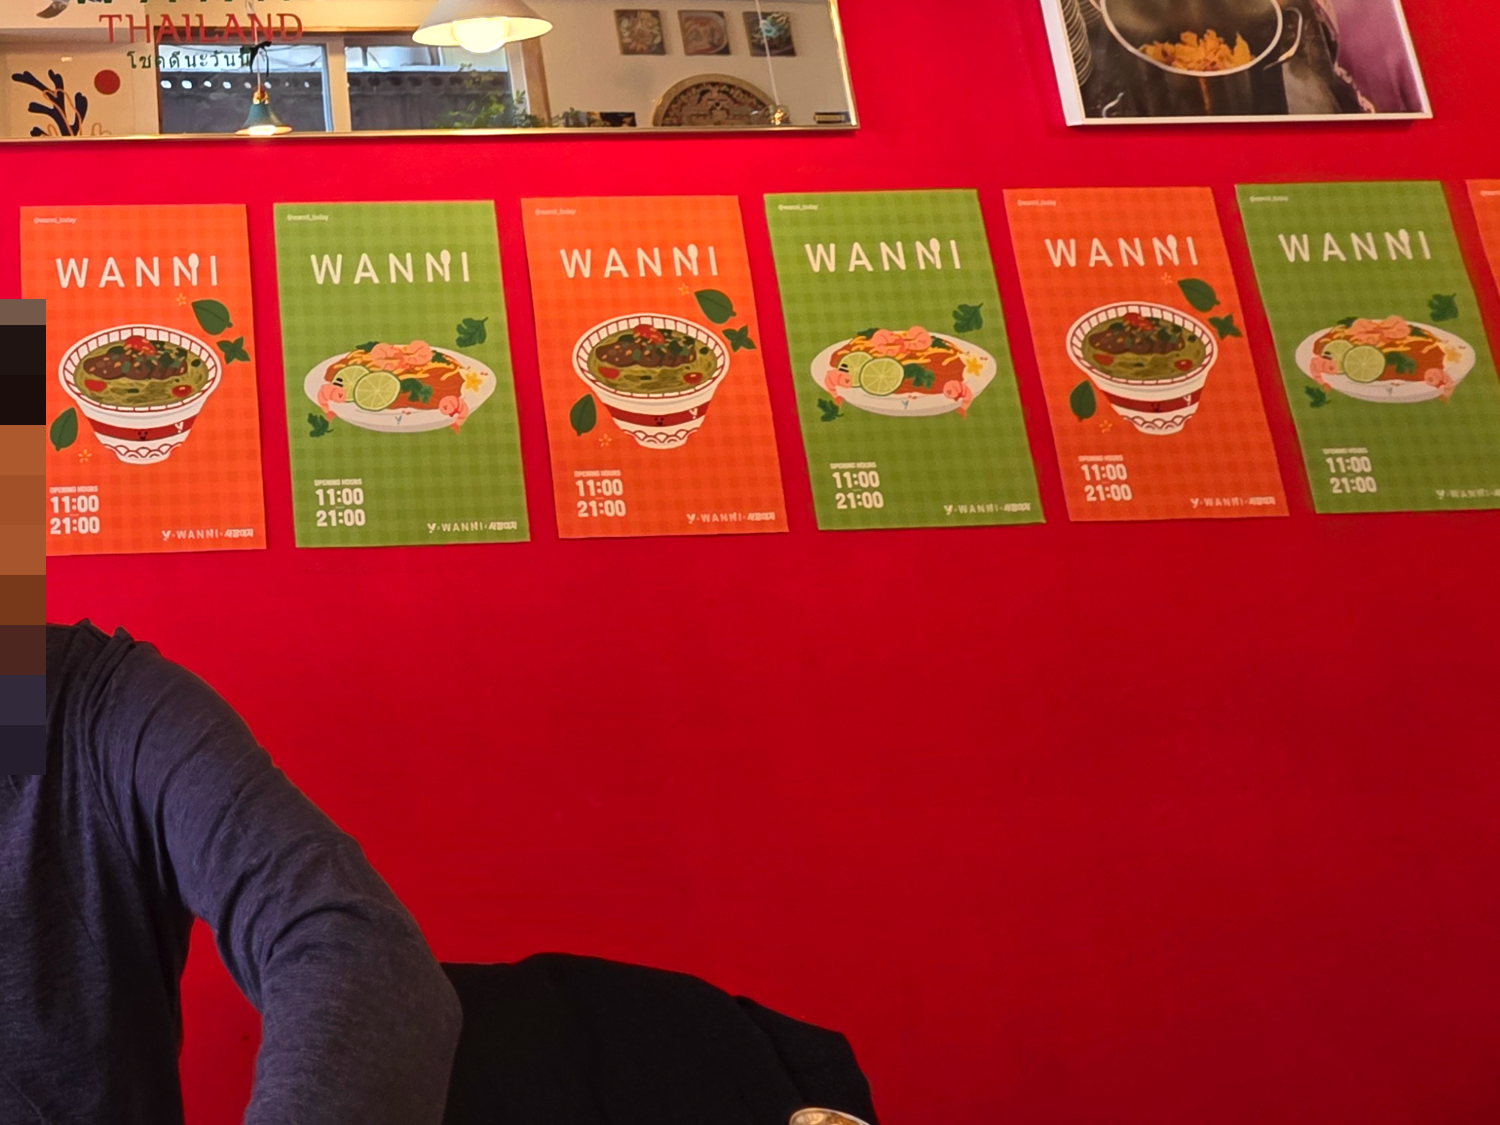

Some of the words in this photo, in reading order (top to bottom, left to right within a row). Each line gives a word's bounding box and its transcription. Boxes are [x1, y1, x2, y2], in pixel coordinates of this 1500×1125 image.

[99, 12, 304, 44] THAILAND
[804, 237, 961, 273] WANNI
[1044, 234, 1198, 268] WANNI
[1277, 228, 1431, 263] WANNI
[55, 252, 218, 289] WANNI
[310, 249, 470, 285] WANNI
[559, 243, 718, 279] WANNI
[1080, 463, 1128, 481] 11:00
[1325, 455, 1372, 474] 11:00
[575, 478, 624, 497] 11:00
[832, 470, 880, 489] 11:00
[1329, 475, 1378, 494] 21:00
[315, 487, 364, 506] 11:00
[835, 490, 884, 510] 21:00
[1084, 483, 1133, 502] 21:00
[50, 494, 100, 514] 11:00
[576, 499, 627, 518] 21:00
[49, 515, 100, 535] 21:00
[315, 508, 366, 527] 21:00
[441, 521, 484, 532] WANNI
[176, 528, 219, 540] WANNI
